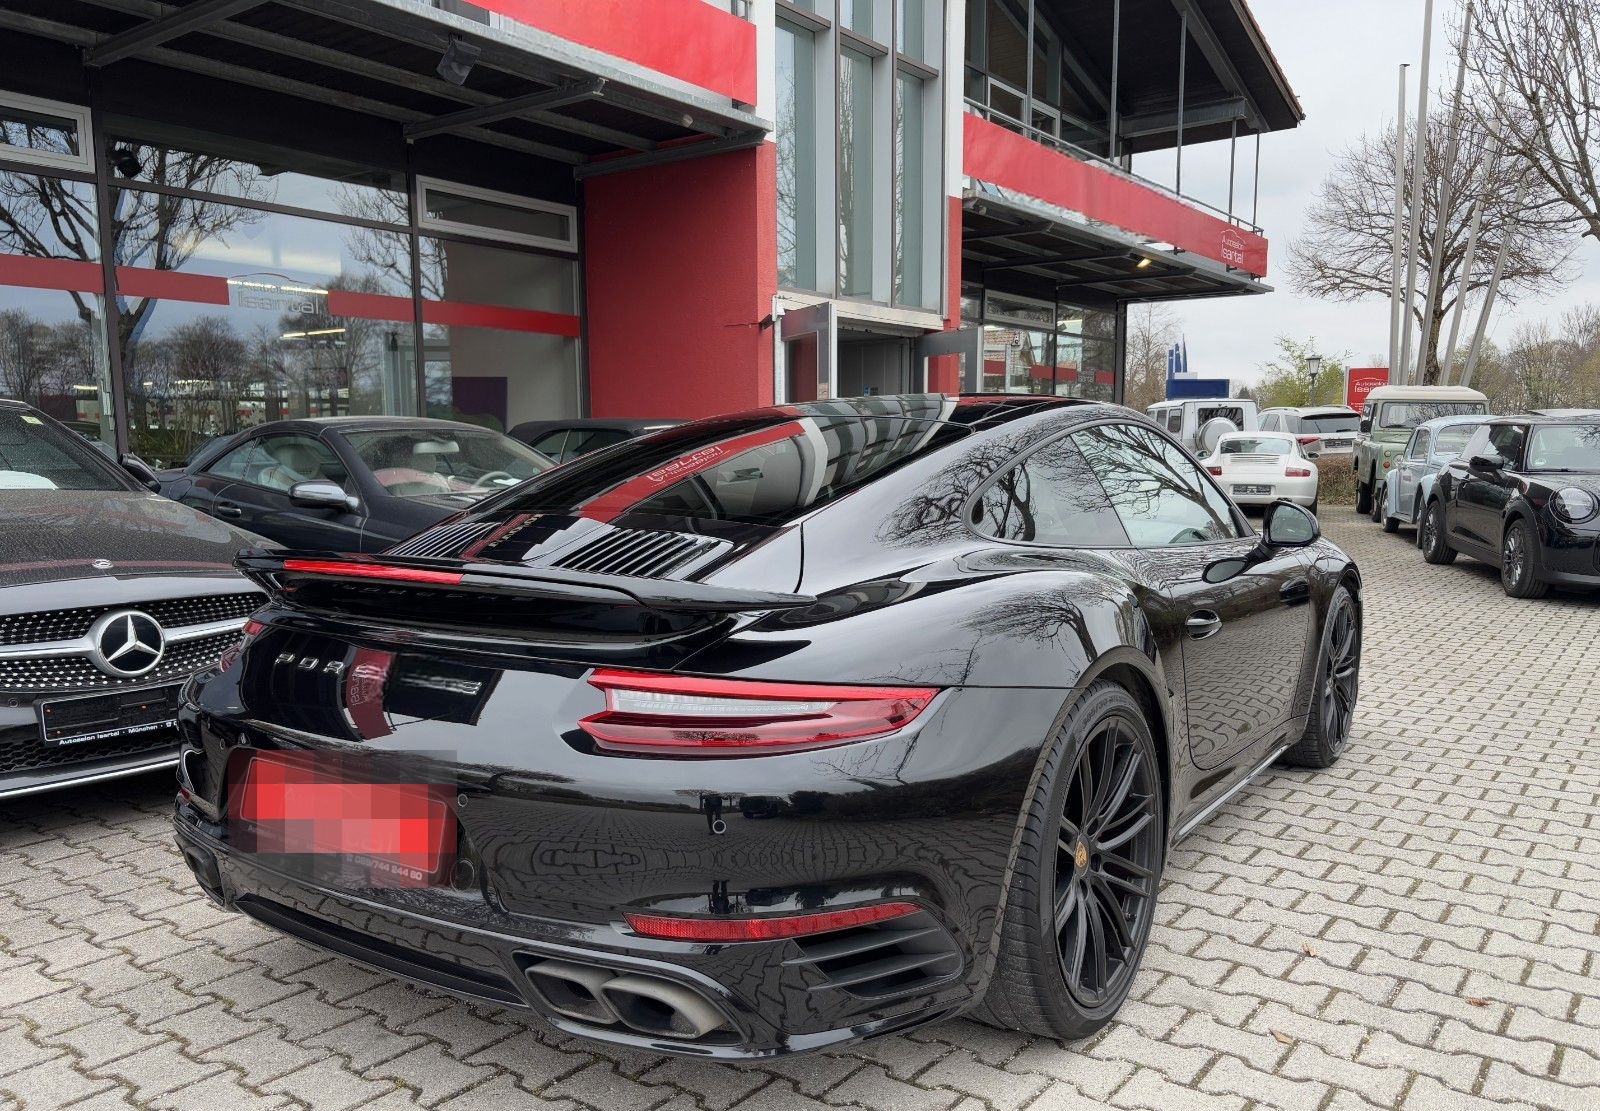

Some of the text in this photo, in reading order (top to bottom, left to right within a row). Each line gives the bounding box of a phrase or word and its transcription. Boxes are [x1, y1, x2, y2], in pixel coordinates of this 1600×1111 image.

[59, 725, 158, 745] Autosalon Isartal München
